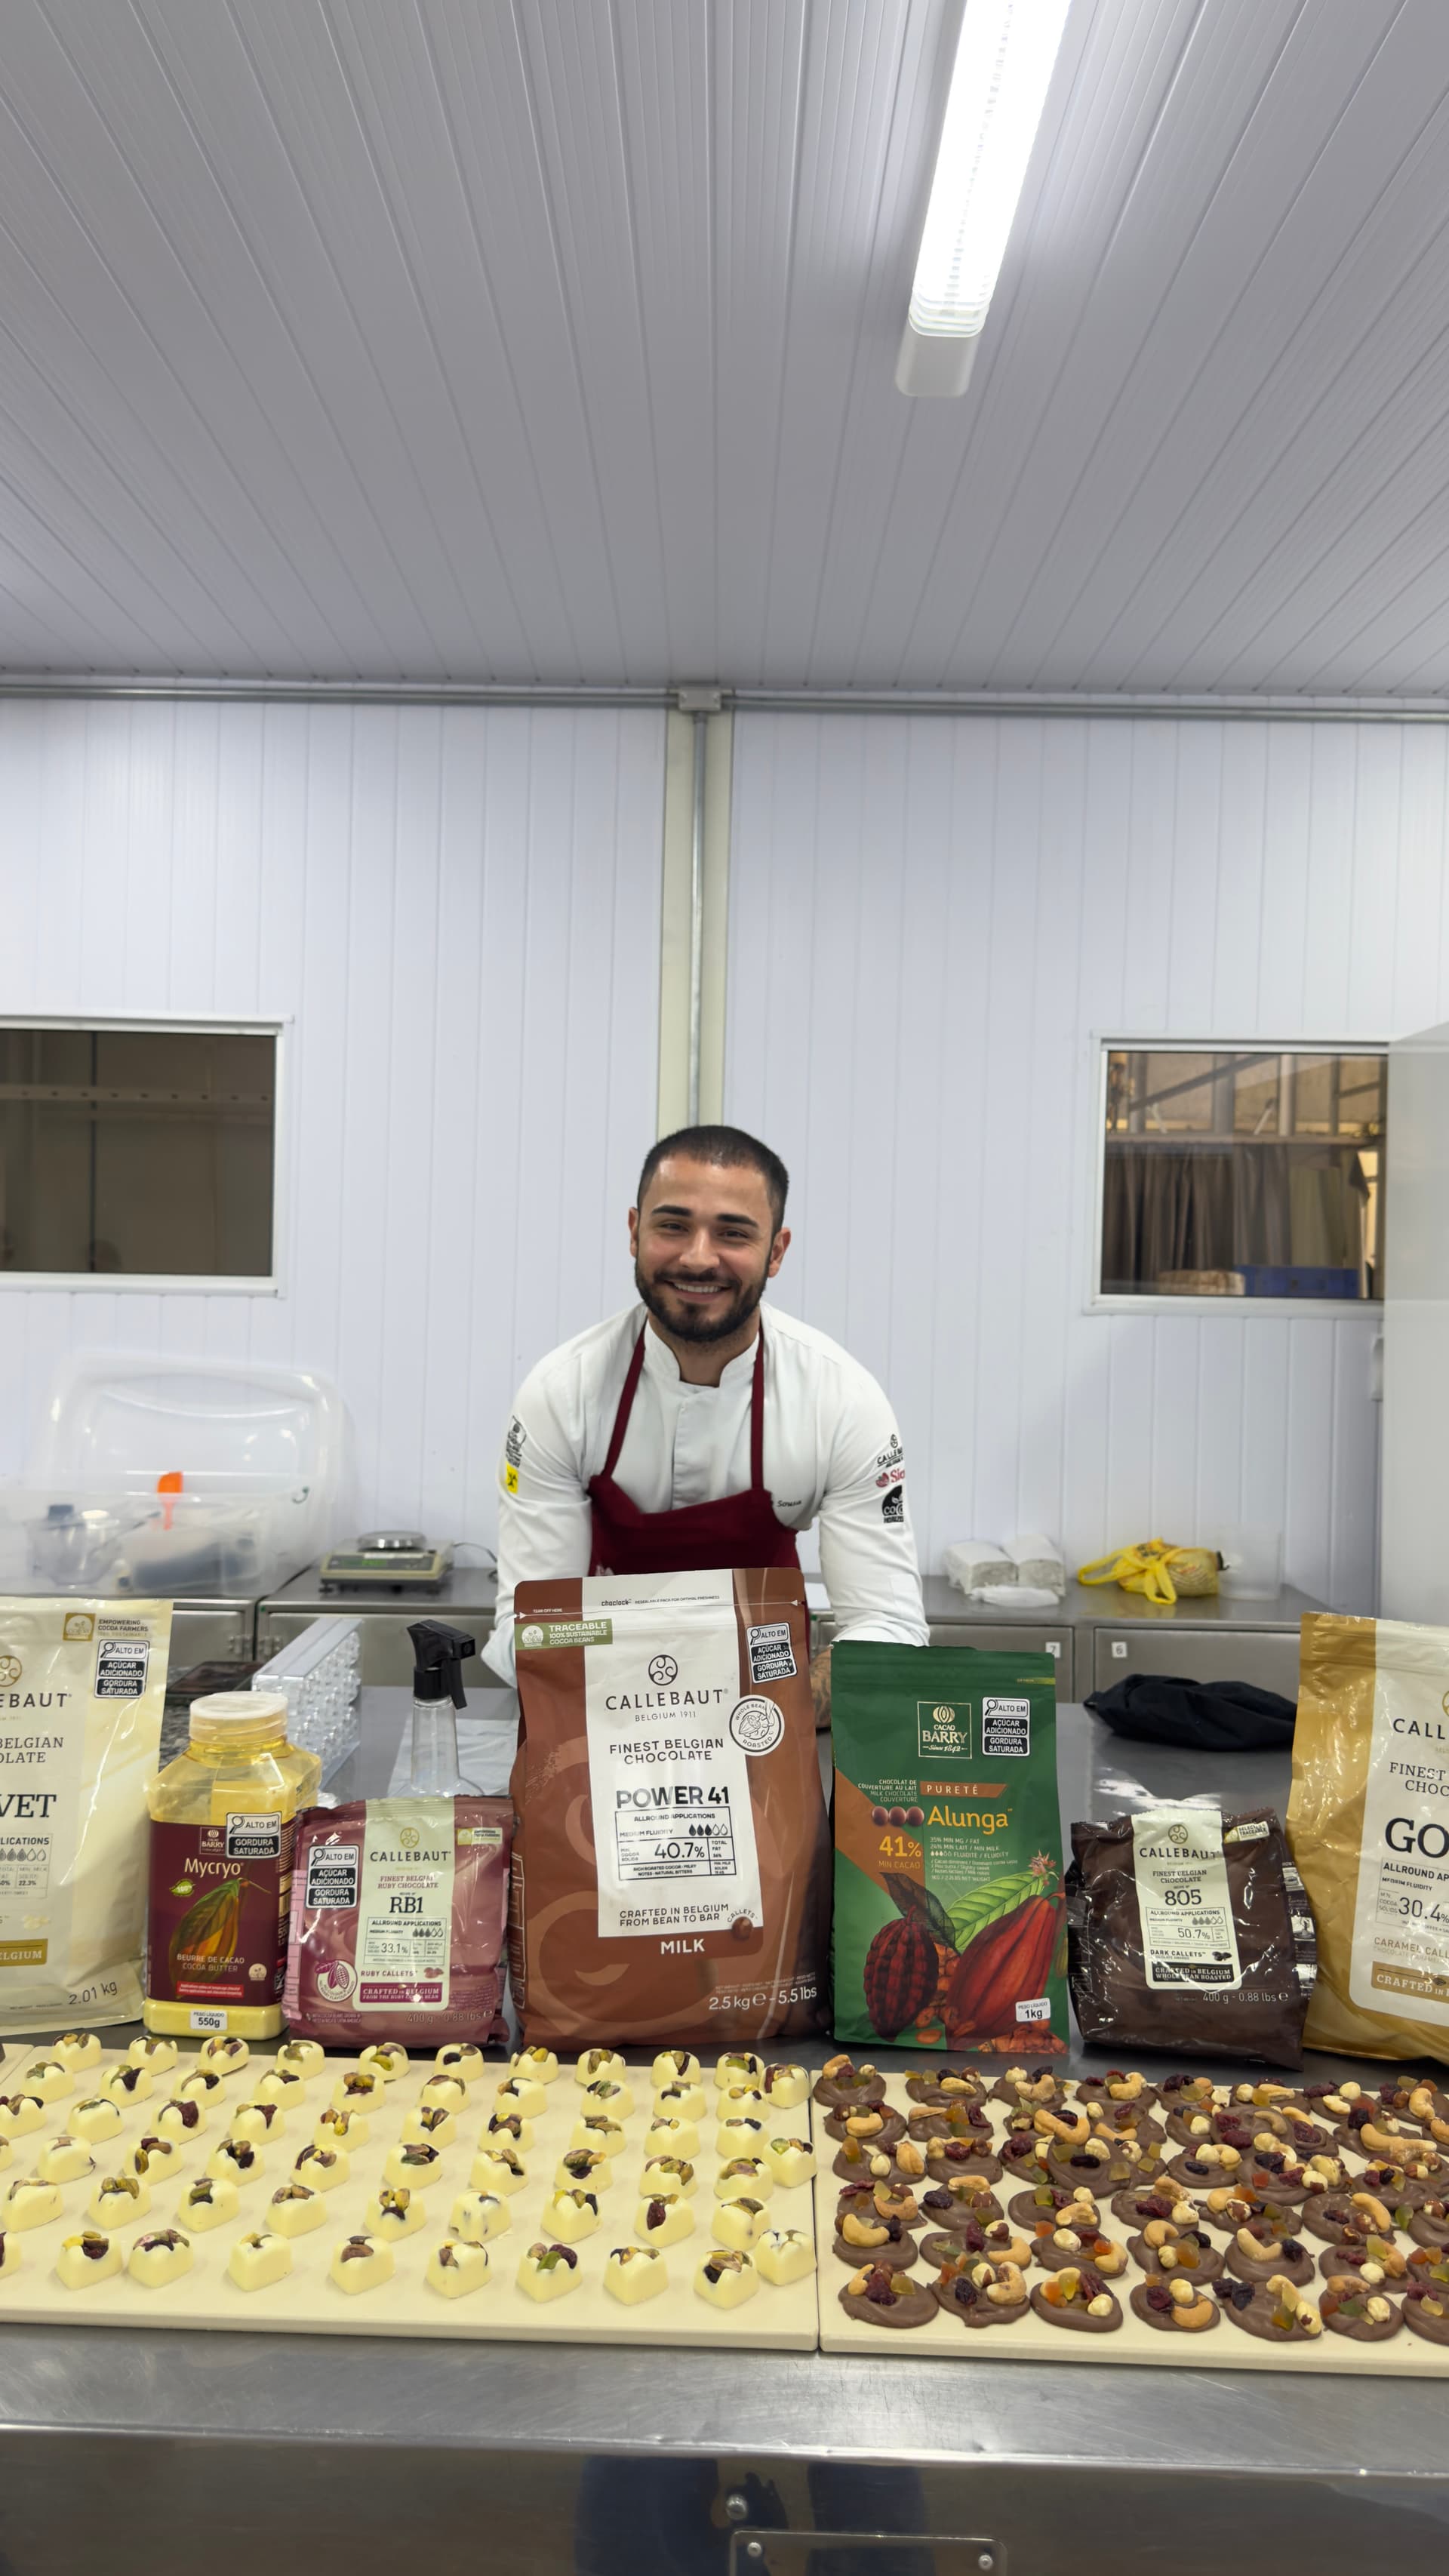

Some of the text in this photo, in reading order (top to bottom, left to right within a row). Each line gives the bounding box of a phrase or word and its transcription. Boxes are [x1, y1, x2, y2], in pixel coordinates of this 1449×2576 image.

[549, 1621, 608, 1633] TRACEABLE
[566, 1630, 608, 1638] SUSTAINABLE
[761, 1630, 776, 1639] ALTO
[758, 1644, 782, 1654] AÇÚCAR
[753, 1651, 789, 1662] ADICIONADO
[757, 1660, 789, 1672] GORDURA
[100, 1669, 143, 1677] ADICIONADO
[757, 1667, 791, 1680] SATURADA
[103, 1679, 137, 1688] GORDURA
[101, 1687, 138, 1695] SATURADA
[605, 1688, 723, 1710] CALLEBAUT
[635, 1710, 697, 1722] BELGIUM 1911
[736, 1704, 749, 1721] WHOLE
[992, 1718, 1020, 1728] AÇÚCAR
[1392, 1718, 1446, 1740] CALL
[922, 1730, 968, 1744] BARRY
[986, 1727, 1026, 1735] ADICIONADO
[610, 1737, 724, 1754] FINEST BELGIAN
[742, 1736, 773, 1748] ROASTED
[989, 1737, 1023, 1745] GORDURA
[943, 1744, 961, 1753] 1842
[989, 1745, 1024, 1753] SATURADA
[623, 1750, 712, 1765] CHOCOLATE
[1389, 1762, 1446, 1781] FINEST
[926, 1784, 979, 1796] PURETÉ
[1404, 1780, 1449, 1797] CHOC
[616, 1786, 730, 1809] POWER 41
[266, 1820, 277, 1828] EM
[927, 1805, 1009, 1836] Alunga
[235, 1838, 273, 1846] GORDURA
[1385, 1817, 1449, 1859] GO
[654, 1841, 705, 1860] 40.7%
[878, 1835, 921, 1858] 41%
[370, 1851, 448, 1862] CALLEBAUT
[1140, 1847, 1216, 1860] CALLEBAUT
[184, 1857, 241, 1879] Mycryo
[878, 1860, 921, 1870] MIN CACAO
[1383, 1862, 1435, 1879] ALLROUND
[318, 1867, 348, 1878] AÇÚCAR
[311, 1877, 354, 1885] ADICIONADO
[1406, 1882, 1433, 1891] FLUIDITY
[315, 1888, 349, 1897] GORDURA
[1164, 1888, 1202, 1907] 805
[389, 1896, 423, 1913] RB1
[1379, 1898, 1398, 1907] COCOA
[619, 1904, 729, 1919] CRAFTED IN BELGIUM
[727, 1908, 755, 1923] CALLETS
[1398, 1897, 1449, 1923] 30.4%
[620, 1913, 720, 1927] FROM BEAN TO BAR
[1177, 1927, 1211, 1940] 50.7%
[380, 1943, 408, 1954] 33.1%
[660, 1938, 706, 1955] MILK
[1374, 1937, 1421, 1953] CARAMEL
[177, 1953, 206, 1962] BEURRE
[183, 1962, 238, 1972] COCOA BUTTER
[1376, 1974, 1432, 1993] CRAFTED
[69, 1981, 118, 2005] 2.01 kg
[709, 1996, 731, 2011] 2.5
[734, 1996, 750, 2011] kg
[778, 1987, 798, 2005] 5.5
[800, 1986, 817, 2001] lbs
[1202, 1993, 1220, 2002] 400
[1223, 1995, 1229, 2005] g
[1238, 1993, 1260, 2002] 0.88
[1261, 1993, 1277, 2002] lbs
[1025, 2009, 1043, 2020] 1kg
[198, 2017, 220, 2028] 550g
